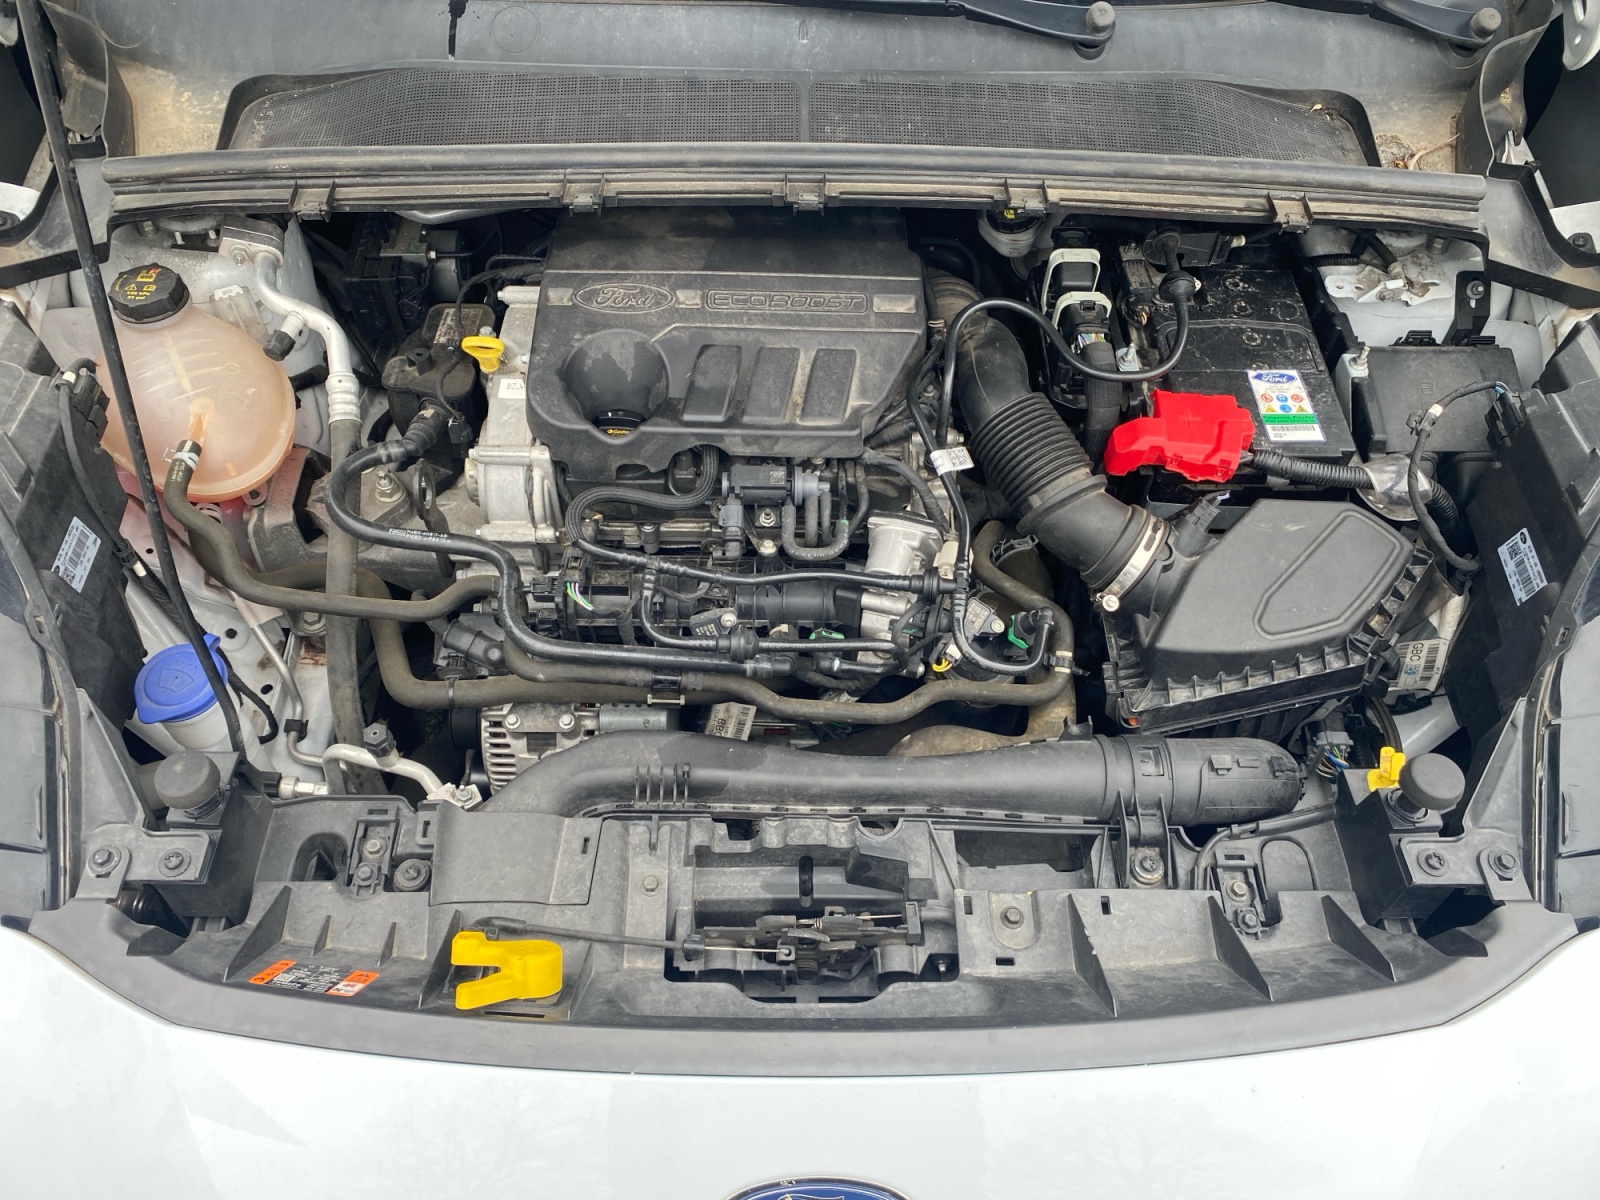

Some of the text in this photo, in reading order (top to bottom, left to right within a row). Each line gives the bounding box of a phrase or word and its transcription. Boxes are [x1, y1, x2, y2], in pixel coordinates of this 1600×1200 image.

[594, 287, 655, 308] Ford
[713, 294, 863, 310] ECOBOOST
[1261, 372, 1288, 383] Ford
[1410, 642, 1424, 661] GBC
